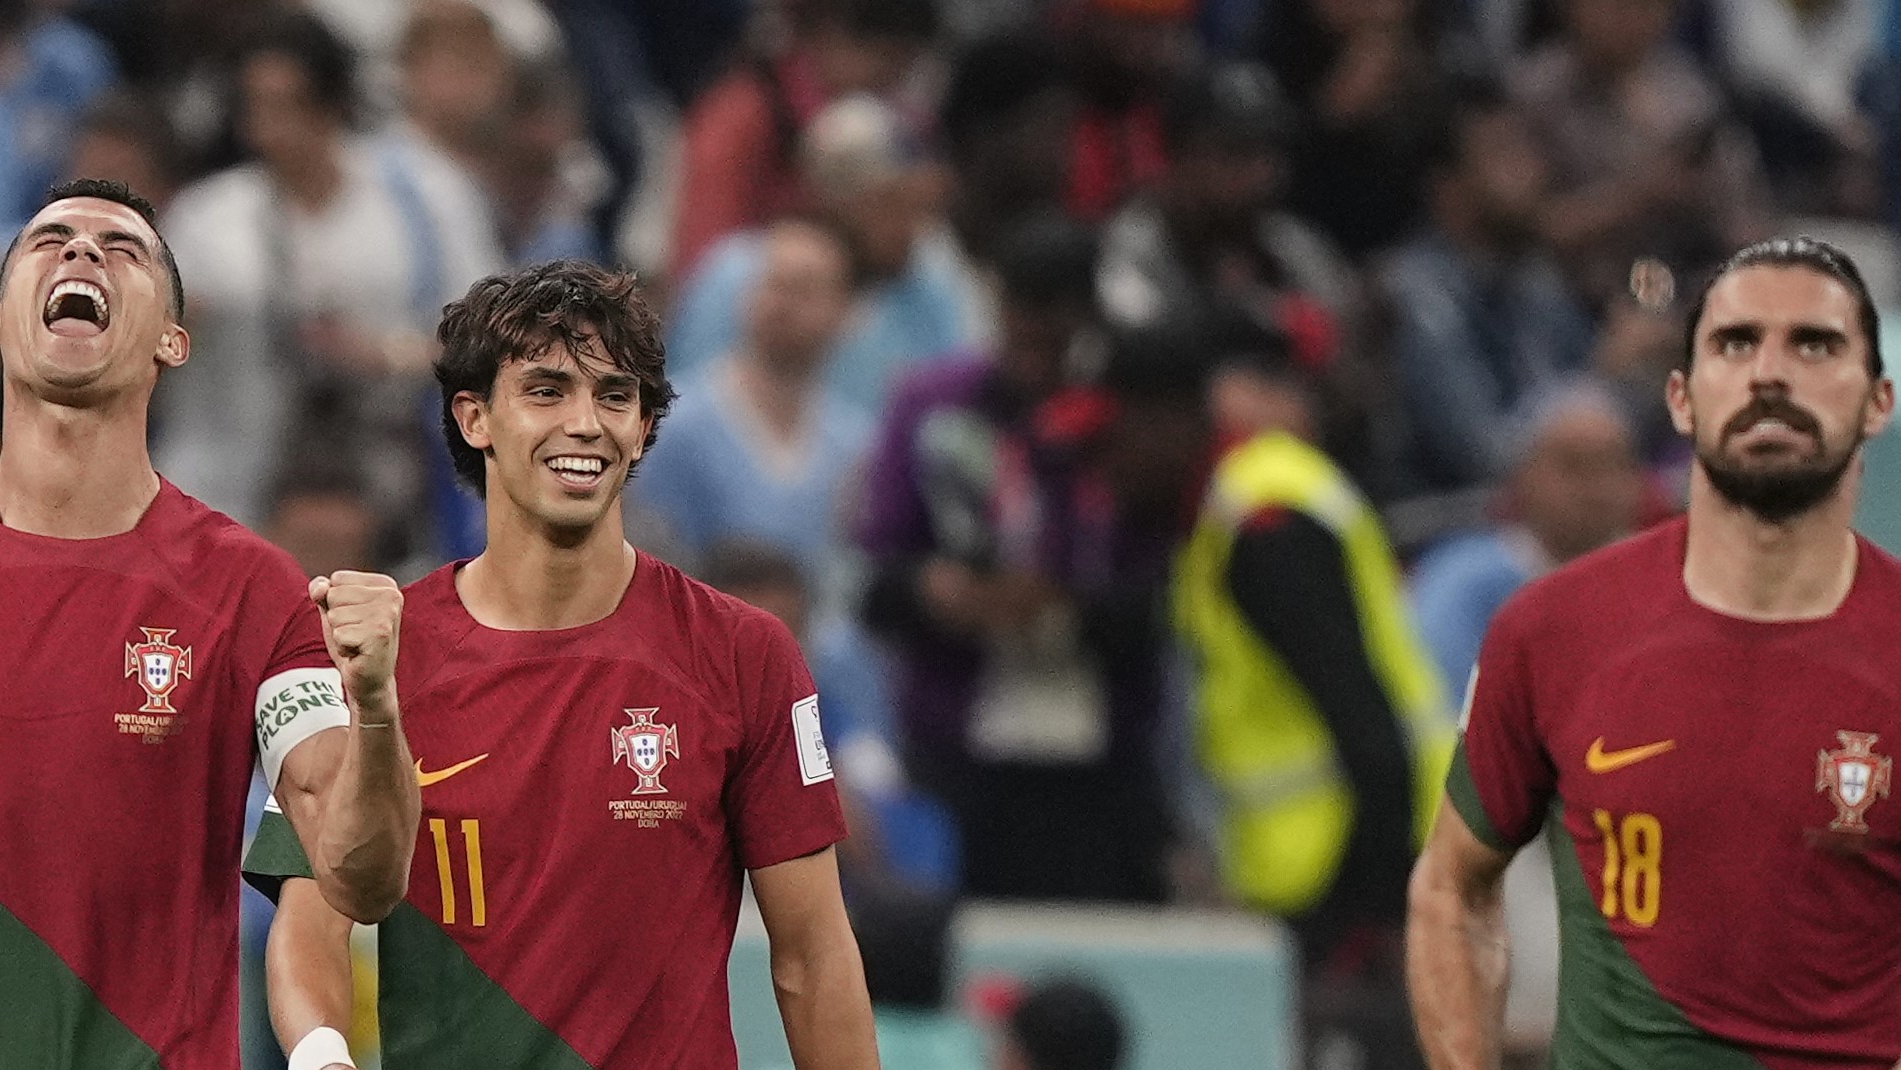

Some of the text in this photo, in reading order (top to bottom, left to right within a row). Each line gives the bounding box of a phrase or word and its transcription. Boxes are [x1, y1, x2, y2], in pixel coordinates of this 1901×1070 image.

[613, 810, 624, 820] 28
[1593, 808, 1663, 927] 18
[429, 817, 487, 927] 11
